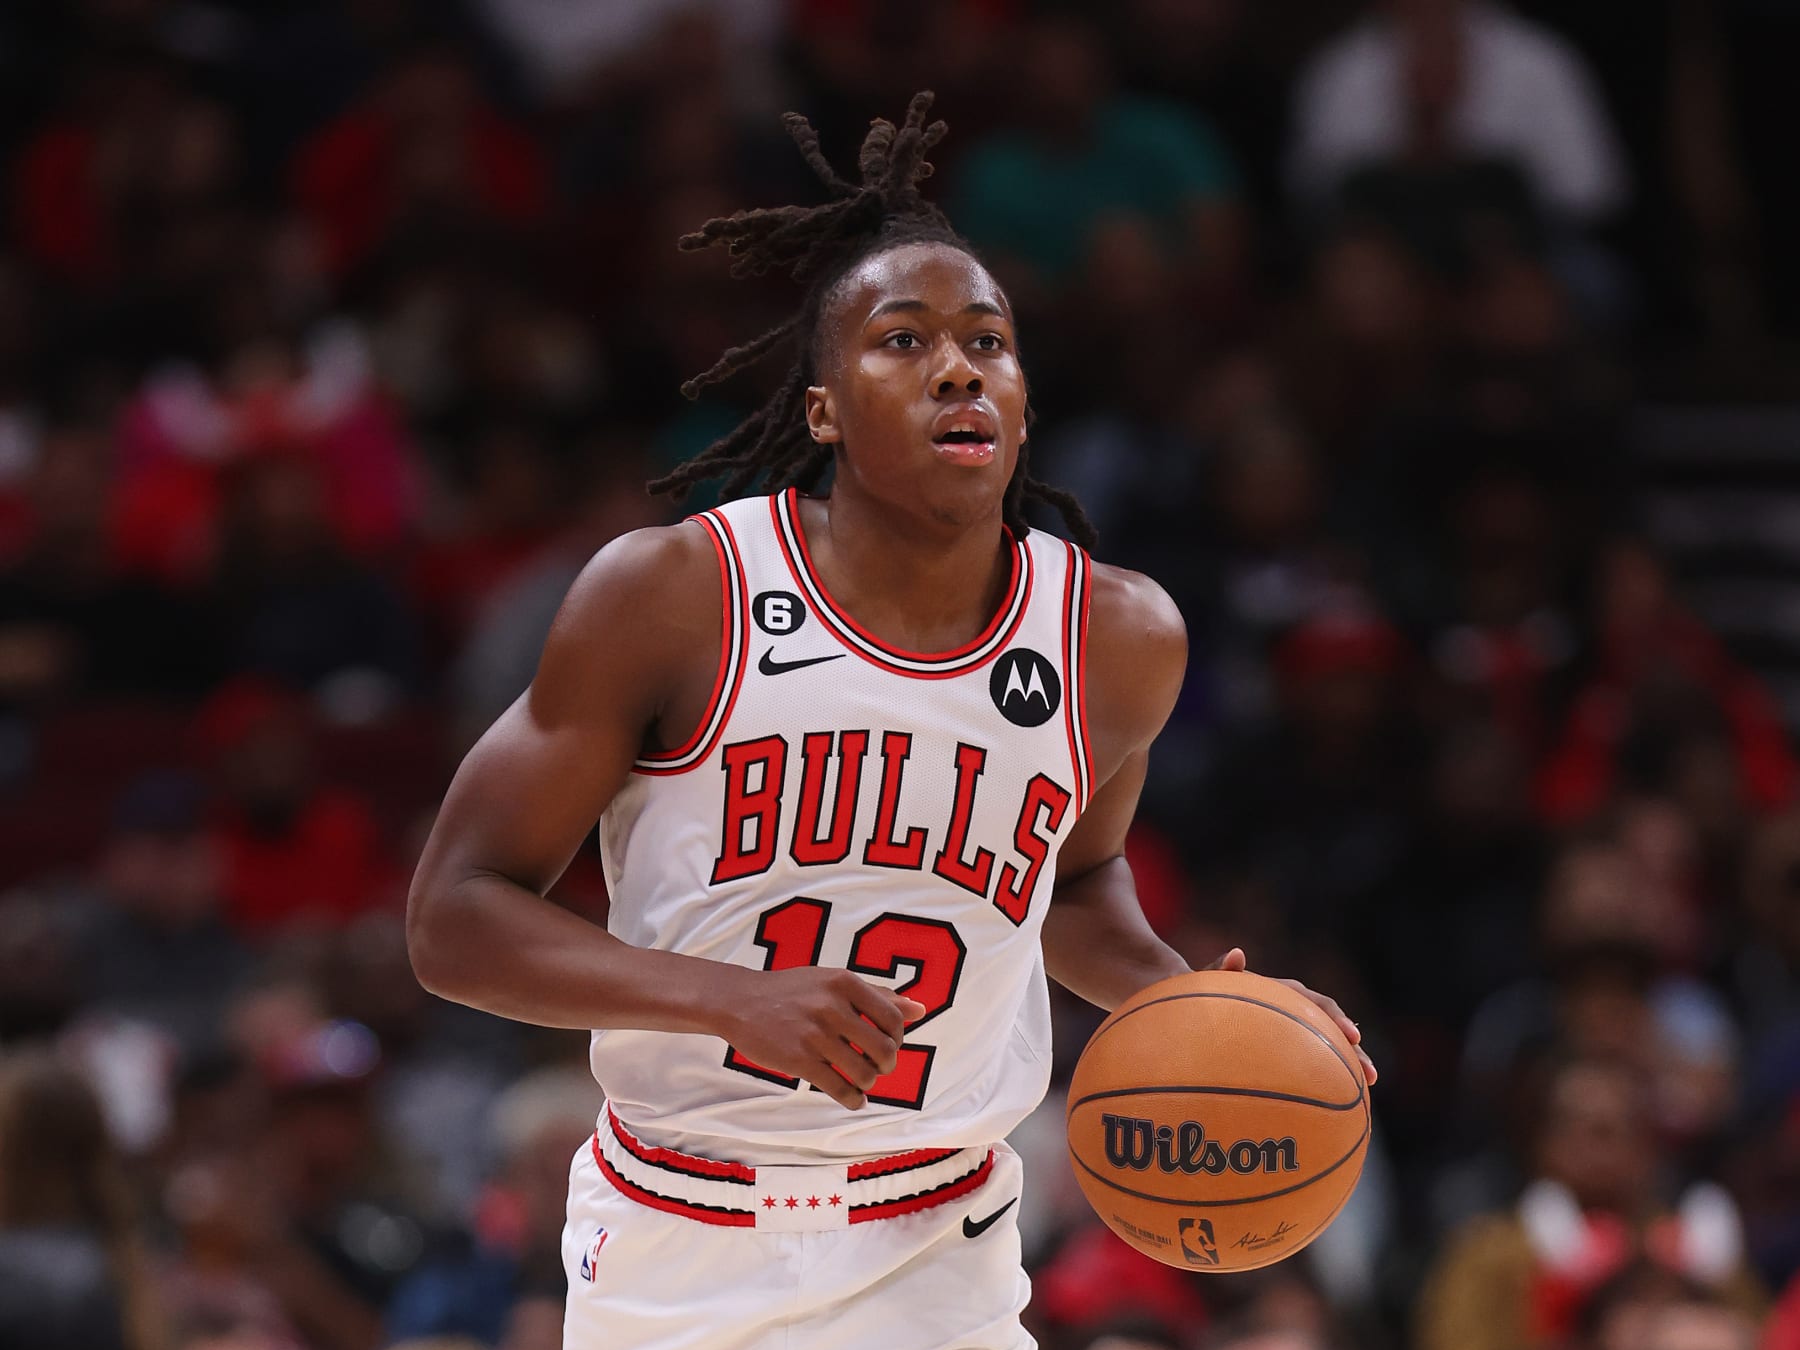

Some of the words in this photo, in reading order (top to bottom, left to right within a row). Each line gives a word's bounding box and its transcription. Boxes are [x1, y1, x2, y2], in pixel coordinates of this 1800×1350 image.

[764, 597, 792, 630] 6
[709, 729, 1073, 928] BULLS
[1101, 1113, 1300, 1176] Wilson
